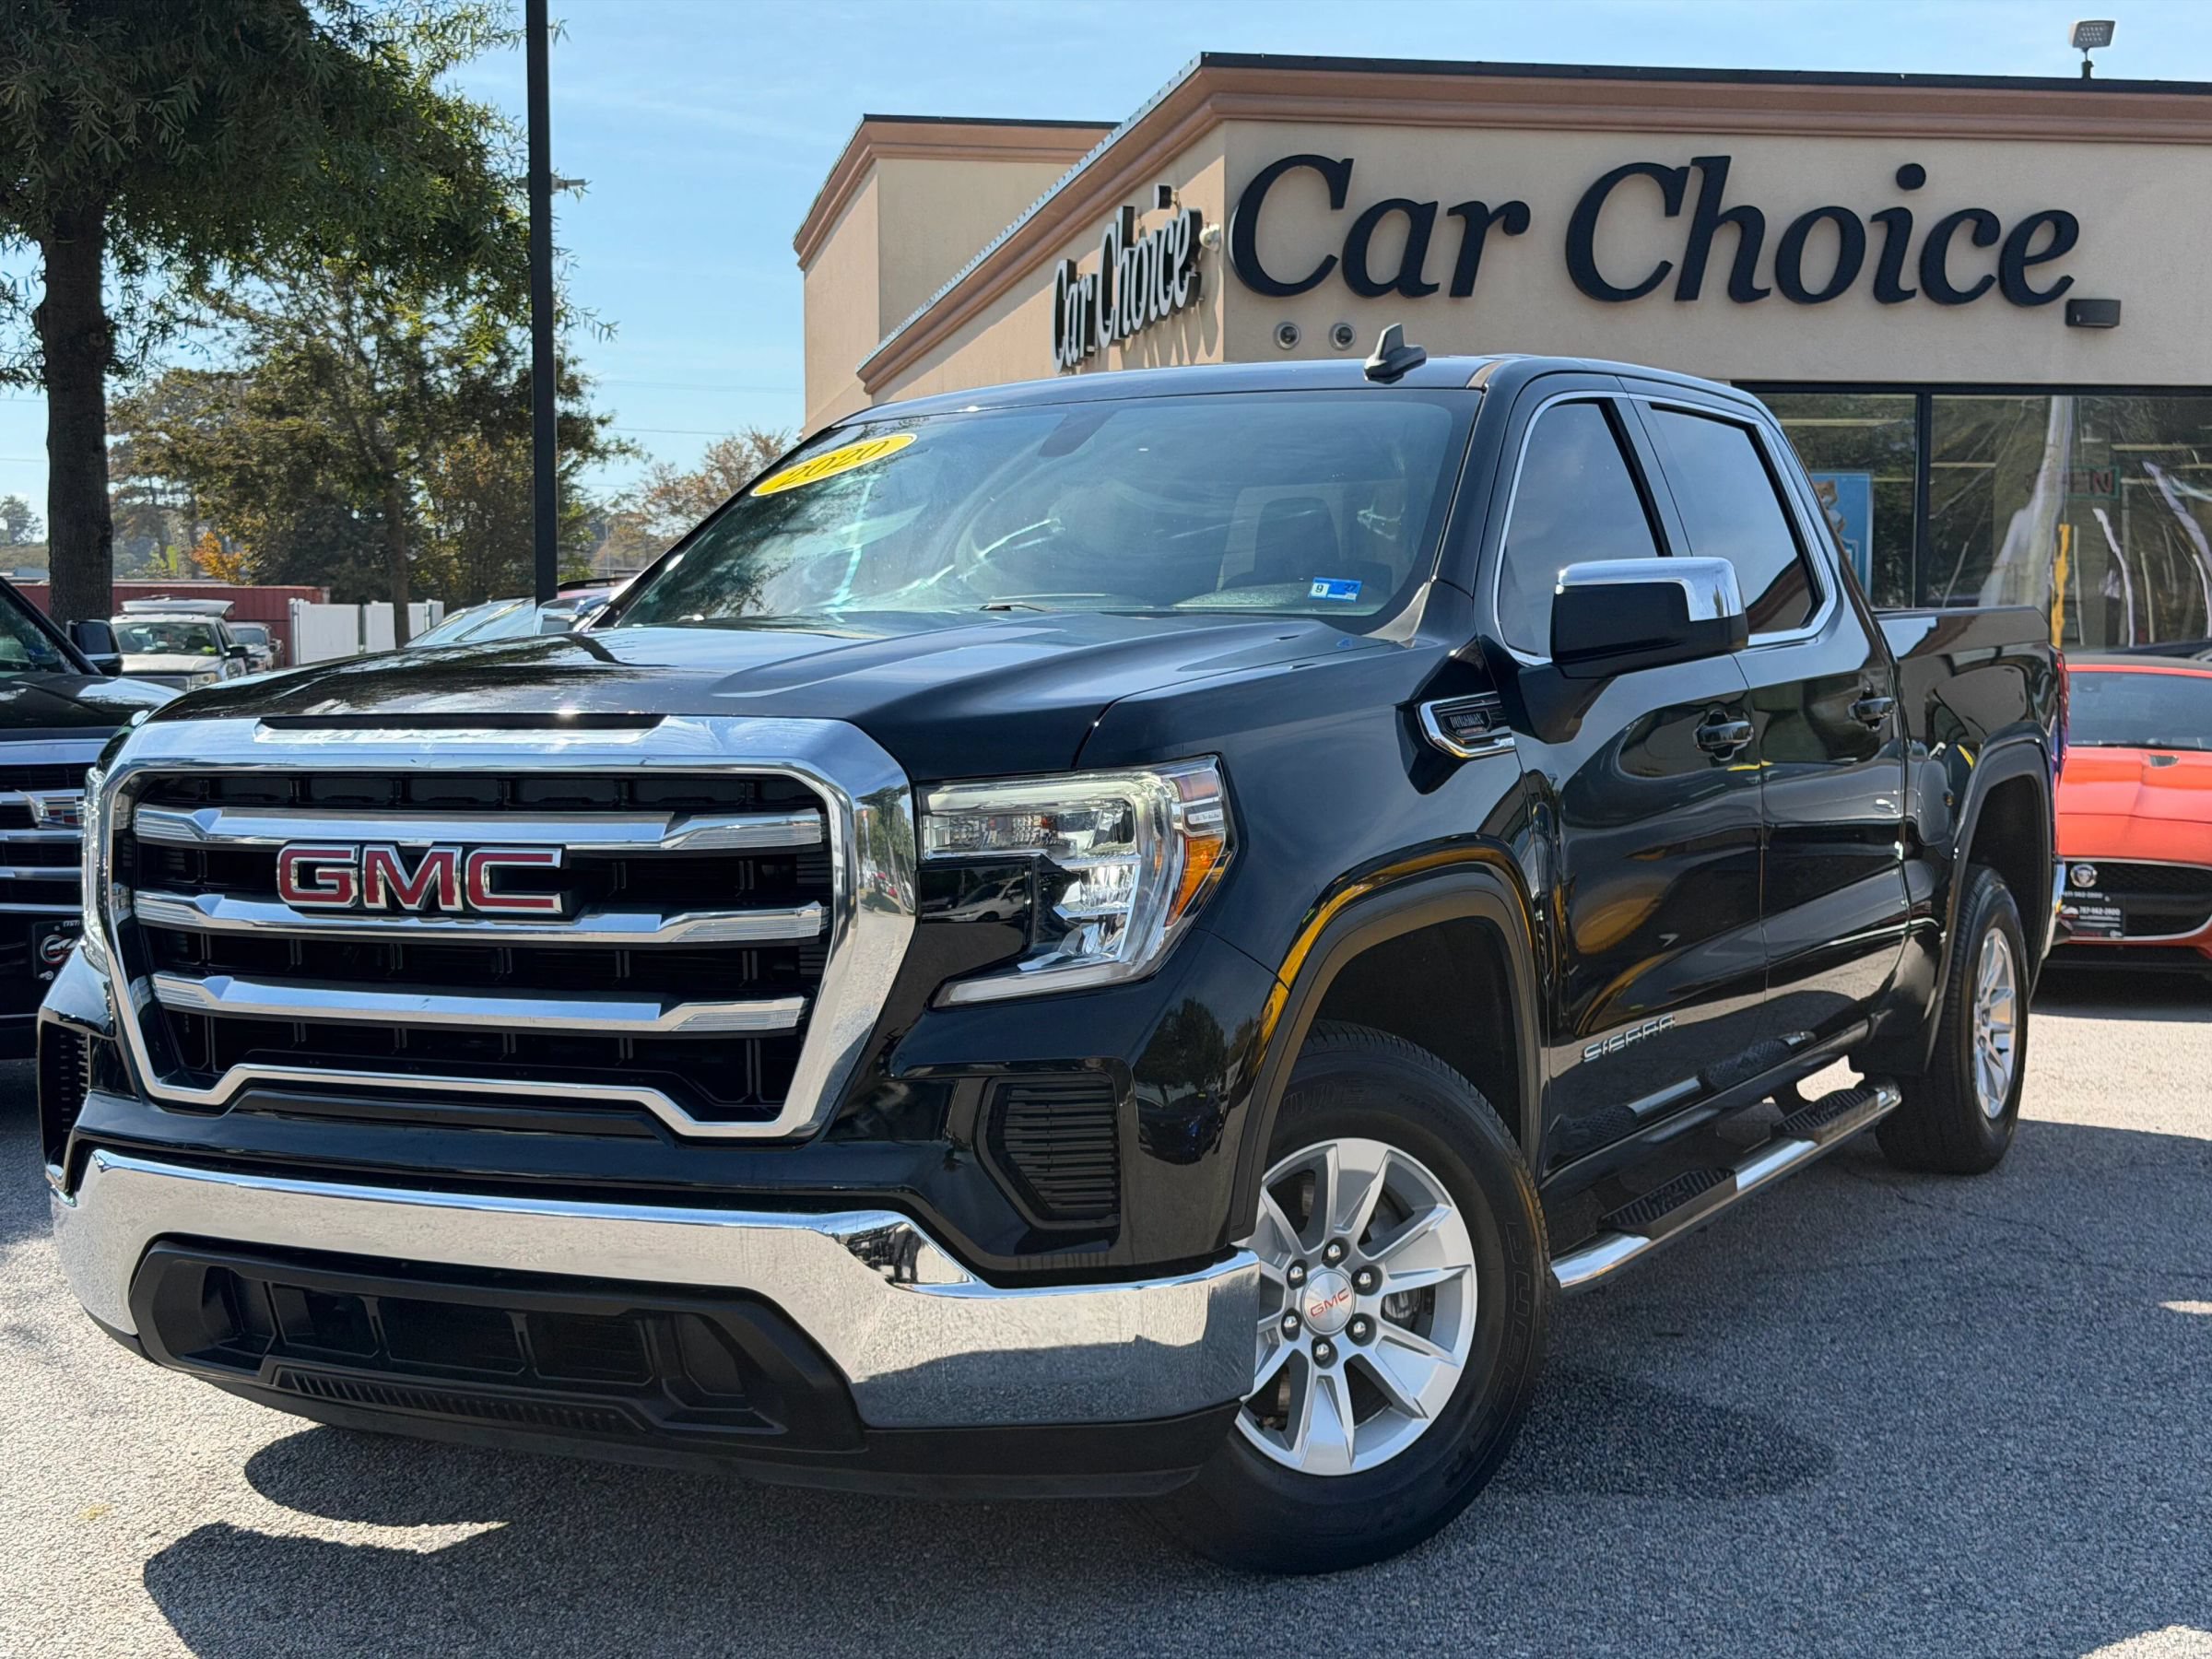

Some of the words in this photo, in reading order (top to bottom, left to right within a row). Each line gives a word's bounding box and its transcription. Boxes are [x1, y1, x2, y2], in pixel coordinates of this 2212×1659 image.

[1231, 153, 1532, 300] Car
[1565, 155, 2080, 308] Choice
[1051, 259, 1095, 371] Car
[1097, 184, 1193, 348] Choice
[775, 440, 890, 489] 2020
[1314, 583, 1324, 594] 9
[276, 843, 562, 913] GMC
[1310, 1287, 1350, 1318] GMC
